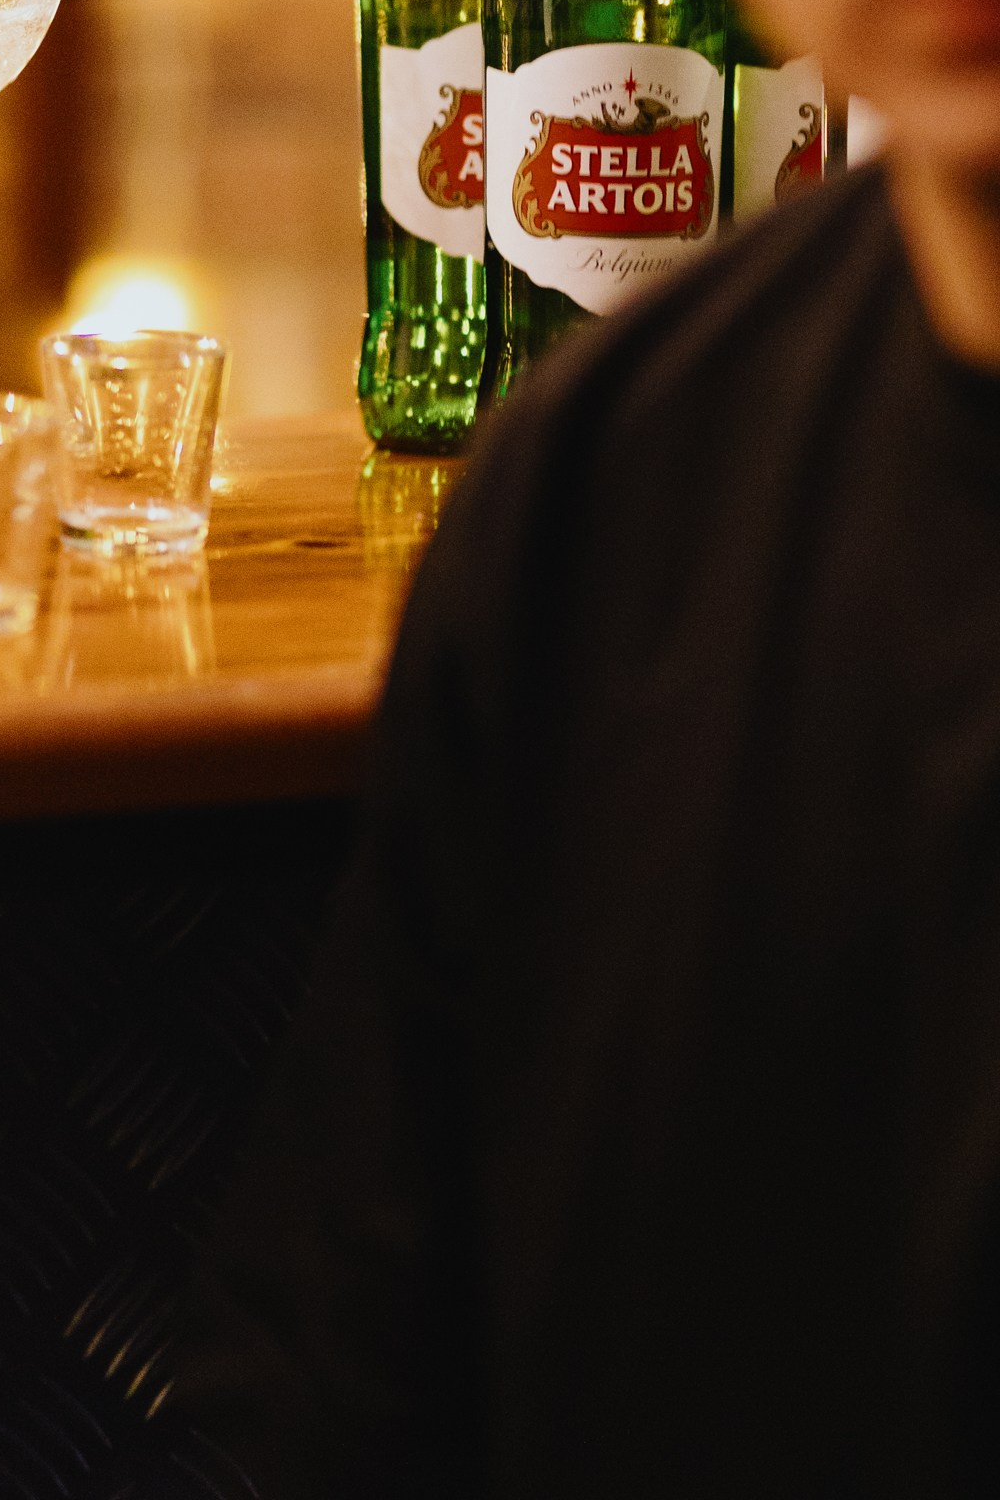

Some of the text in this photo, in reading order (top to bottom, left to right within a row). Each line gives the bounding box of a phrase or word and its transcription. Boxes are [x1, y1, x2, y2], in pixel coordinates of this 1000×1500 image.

[572, 82, 613, 107] ANNO
[551, 142, 693, 178] STELLA
[547, 179, 693, 215] ARTOIS
[567, 247, 673, 284] Belgium
